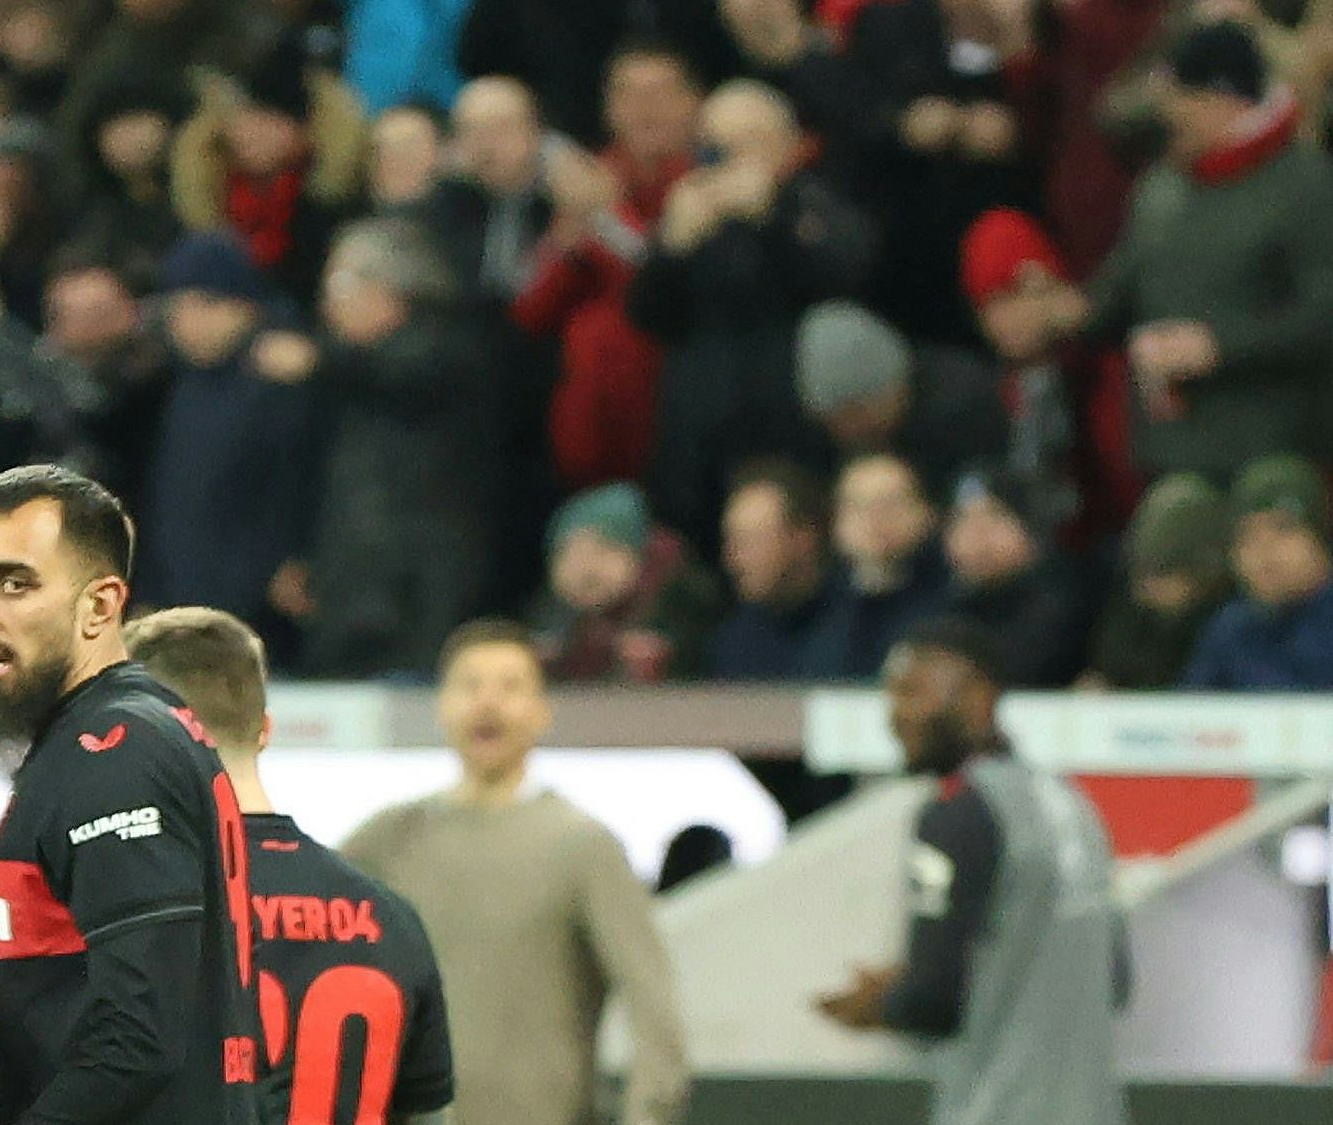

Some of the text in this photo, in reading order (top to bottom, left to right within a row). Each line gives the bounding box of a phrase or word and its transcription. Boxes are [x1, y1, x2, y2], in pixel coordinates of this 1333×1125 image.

[68, 806, 160, 845] KUMHO
[115, 822, 162, 840] TIRE
[252, 896, 381, 944] YER04
